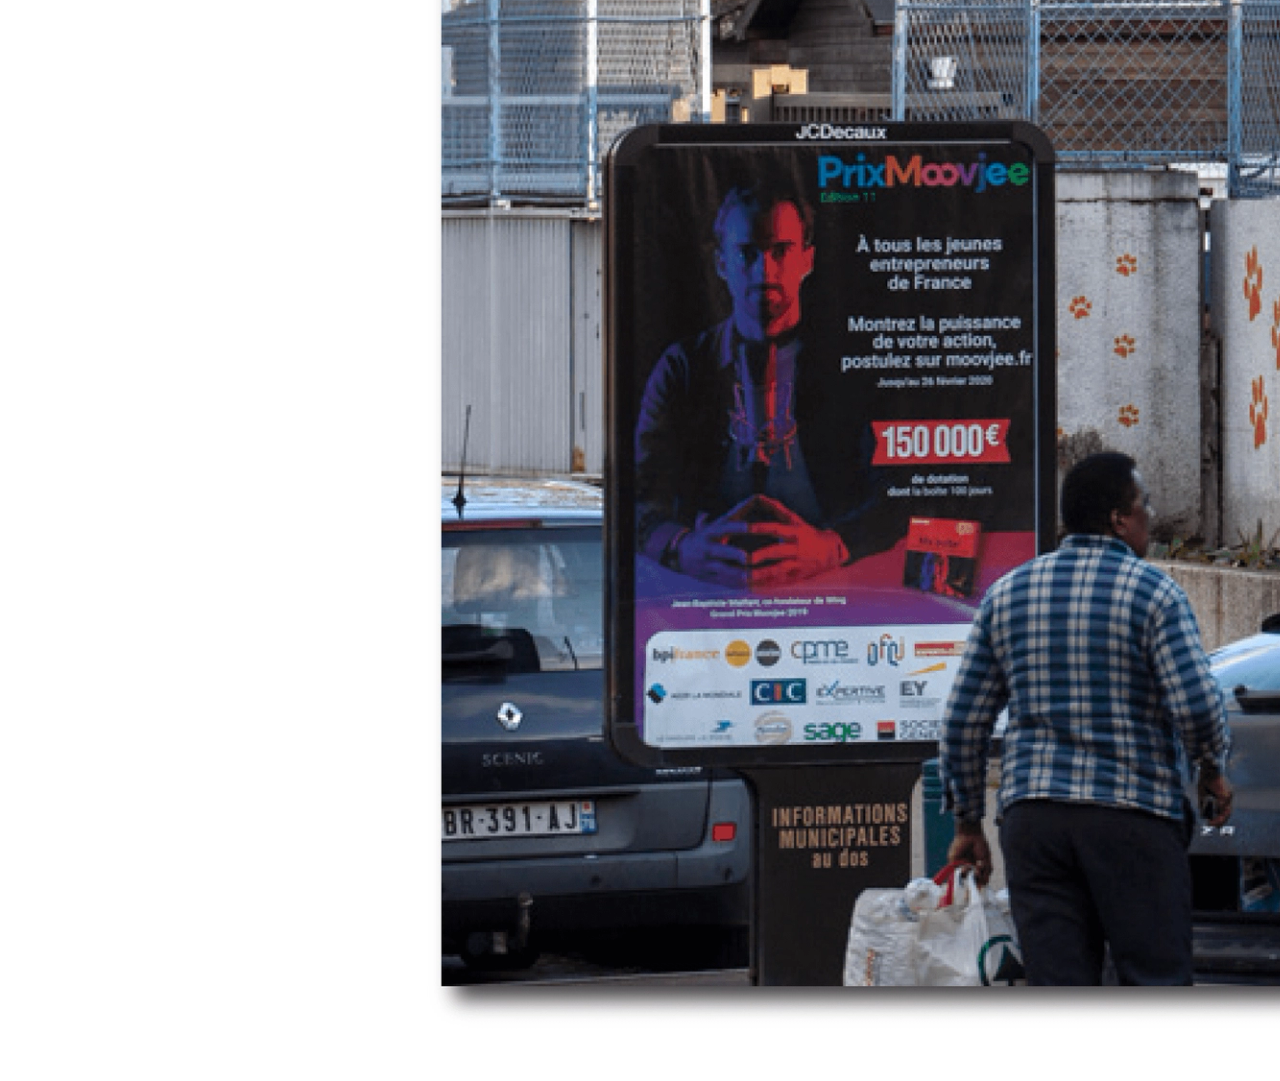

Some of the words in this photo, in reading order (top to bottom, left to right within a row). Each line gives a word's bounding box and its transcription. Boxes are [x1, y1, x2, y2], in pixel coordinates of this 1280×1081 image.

[796, 125, 886, 140] JCDecaux
[817, 152, 1030, 193] PrixMoovjee
[856, 234, 870, 252] À
[874, 238, 912, 252] tous
[917, 237, 942, 252] les
[945, 237, 1003, 254] jeunes
[870, 258, 989, 273] entrepreneurs
[888, 276, 909, 290] de
[914, 276, 972, 290] France
[849, 317, 915, 331] Montrez
[920, 316, 934, 331] la
[939, 316, 1021, 334] puissance
[873, 334, 893, 349] de
[897, 335, 939, 349] votre
[943, 332, 997, 350] action,
[841, 353, 911, 372] postulez
[916, 354, 942, 367] sur
[946, 350, 1033, 368] moovjee.fr
[882, 425, 927, 458] 150
[911, 473, 927, 485] de
[929, 473, 969, 484] dotation
[888, 486, 910, 496] dont
[912, 486, 922, 496] la
[951, 485, 967, 495] 100
[968, 485, 993, 496] jours
[653, 646, 720, 663] bpifrance
[791, 640, 848, 664] cpme
[756, 683, 803, 701] CIC
[900, 681, 928, 697] EY
[803, 721, 863, 743] sage
[443, 804, 578, 836] BR-391-AJ
[772, 803, 908, 827] INFORMATIONS
[778, 826, 900, 849] MUNICIPALES
[812, 852, 831, 868] au
[840, 848, 868, 868] dos
